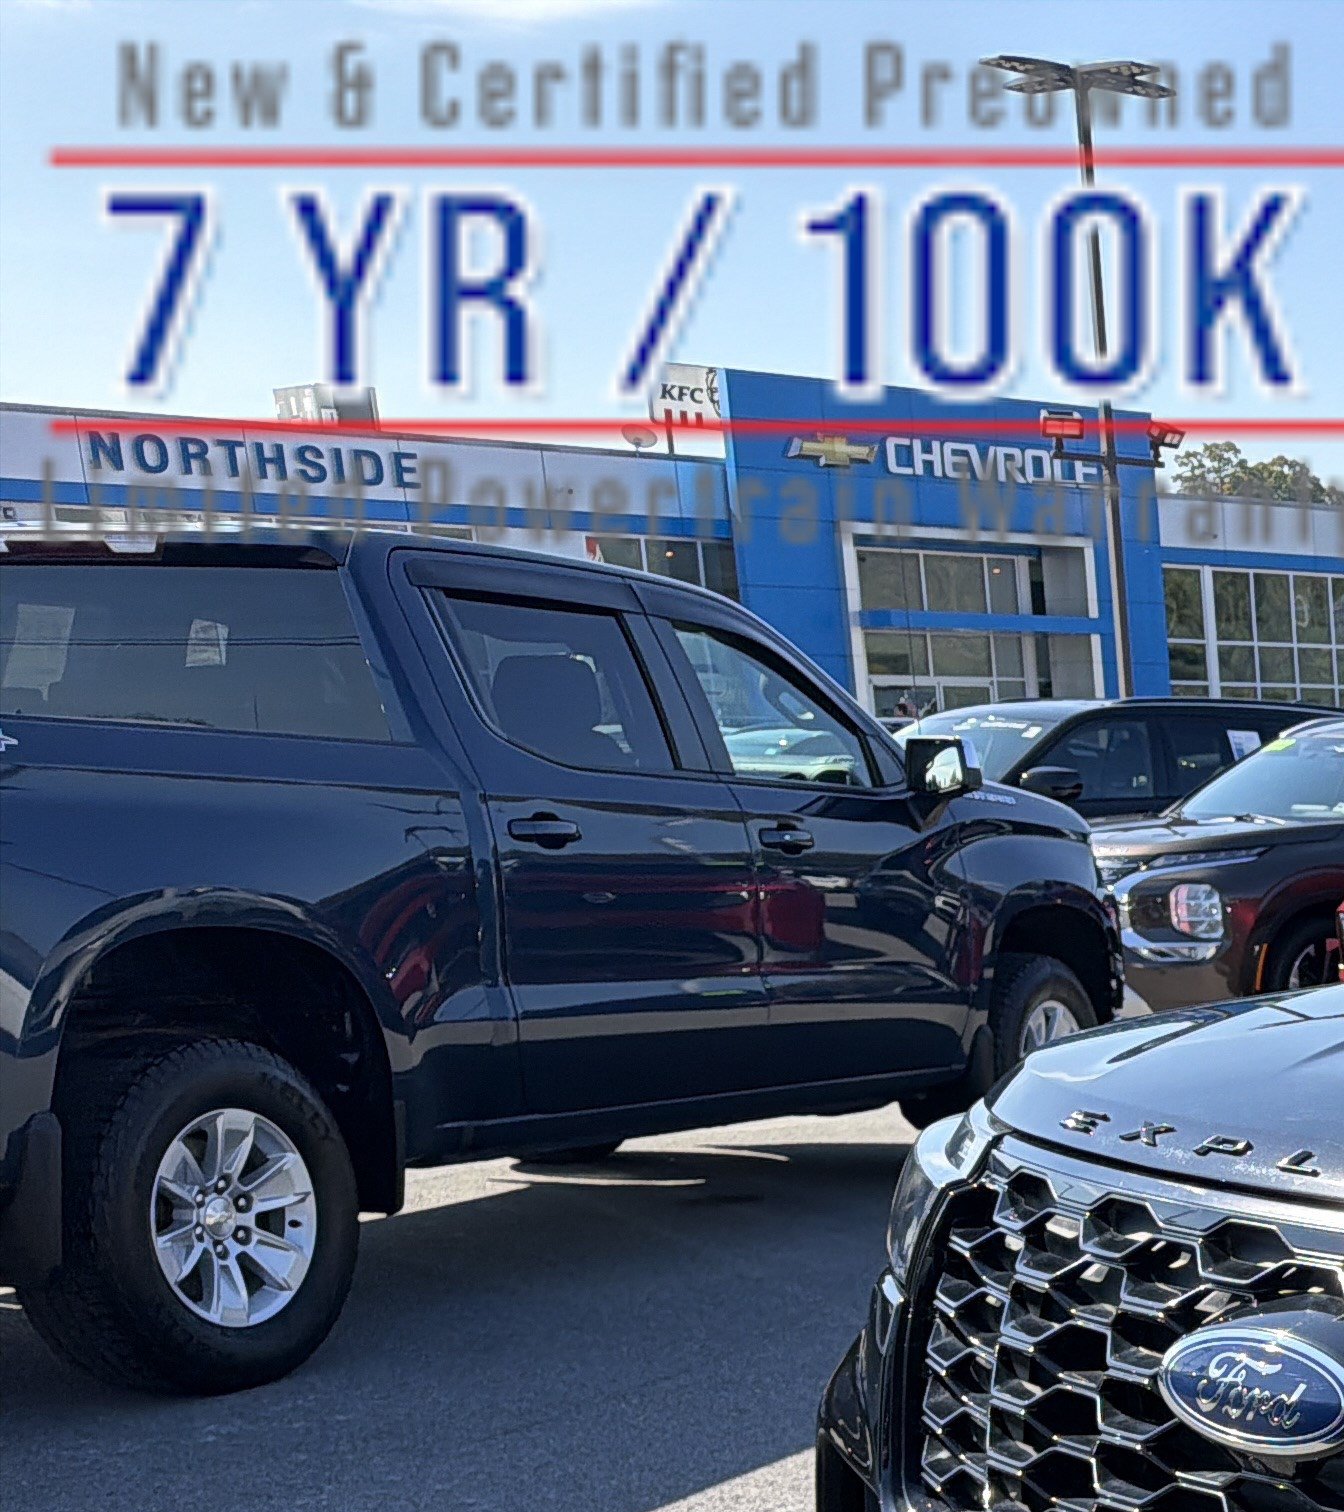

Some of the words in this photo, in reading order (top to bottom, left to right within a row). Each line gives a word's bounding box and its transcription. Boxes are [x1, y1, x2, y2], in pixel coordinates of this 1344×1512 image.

[659, 383, 704, 405] KFC
[86, 430, 422, 490] NORTHSIDE
[884, 436, 1112, 486] CHEVROLE
[1195, 1350, 1307, 1429] Ford
